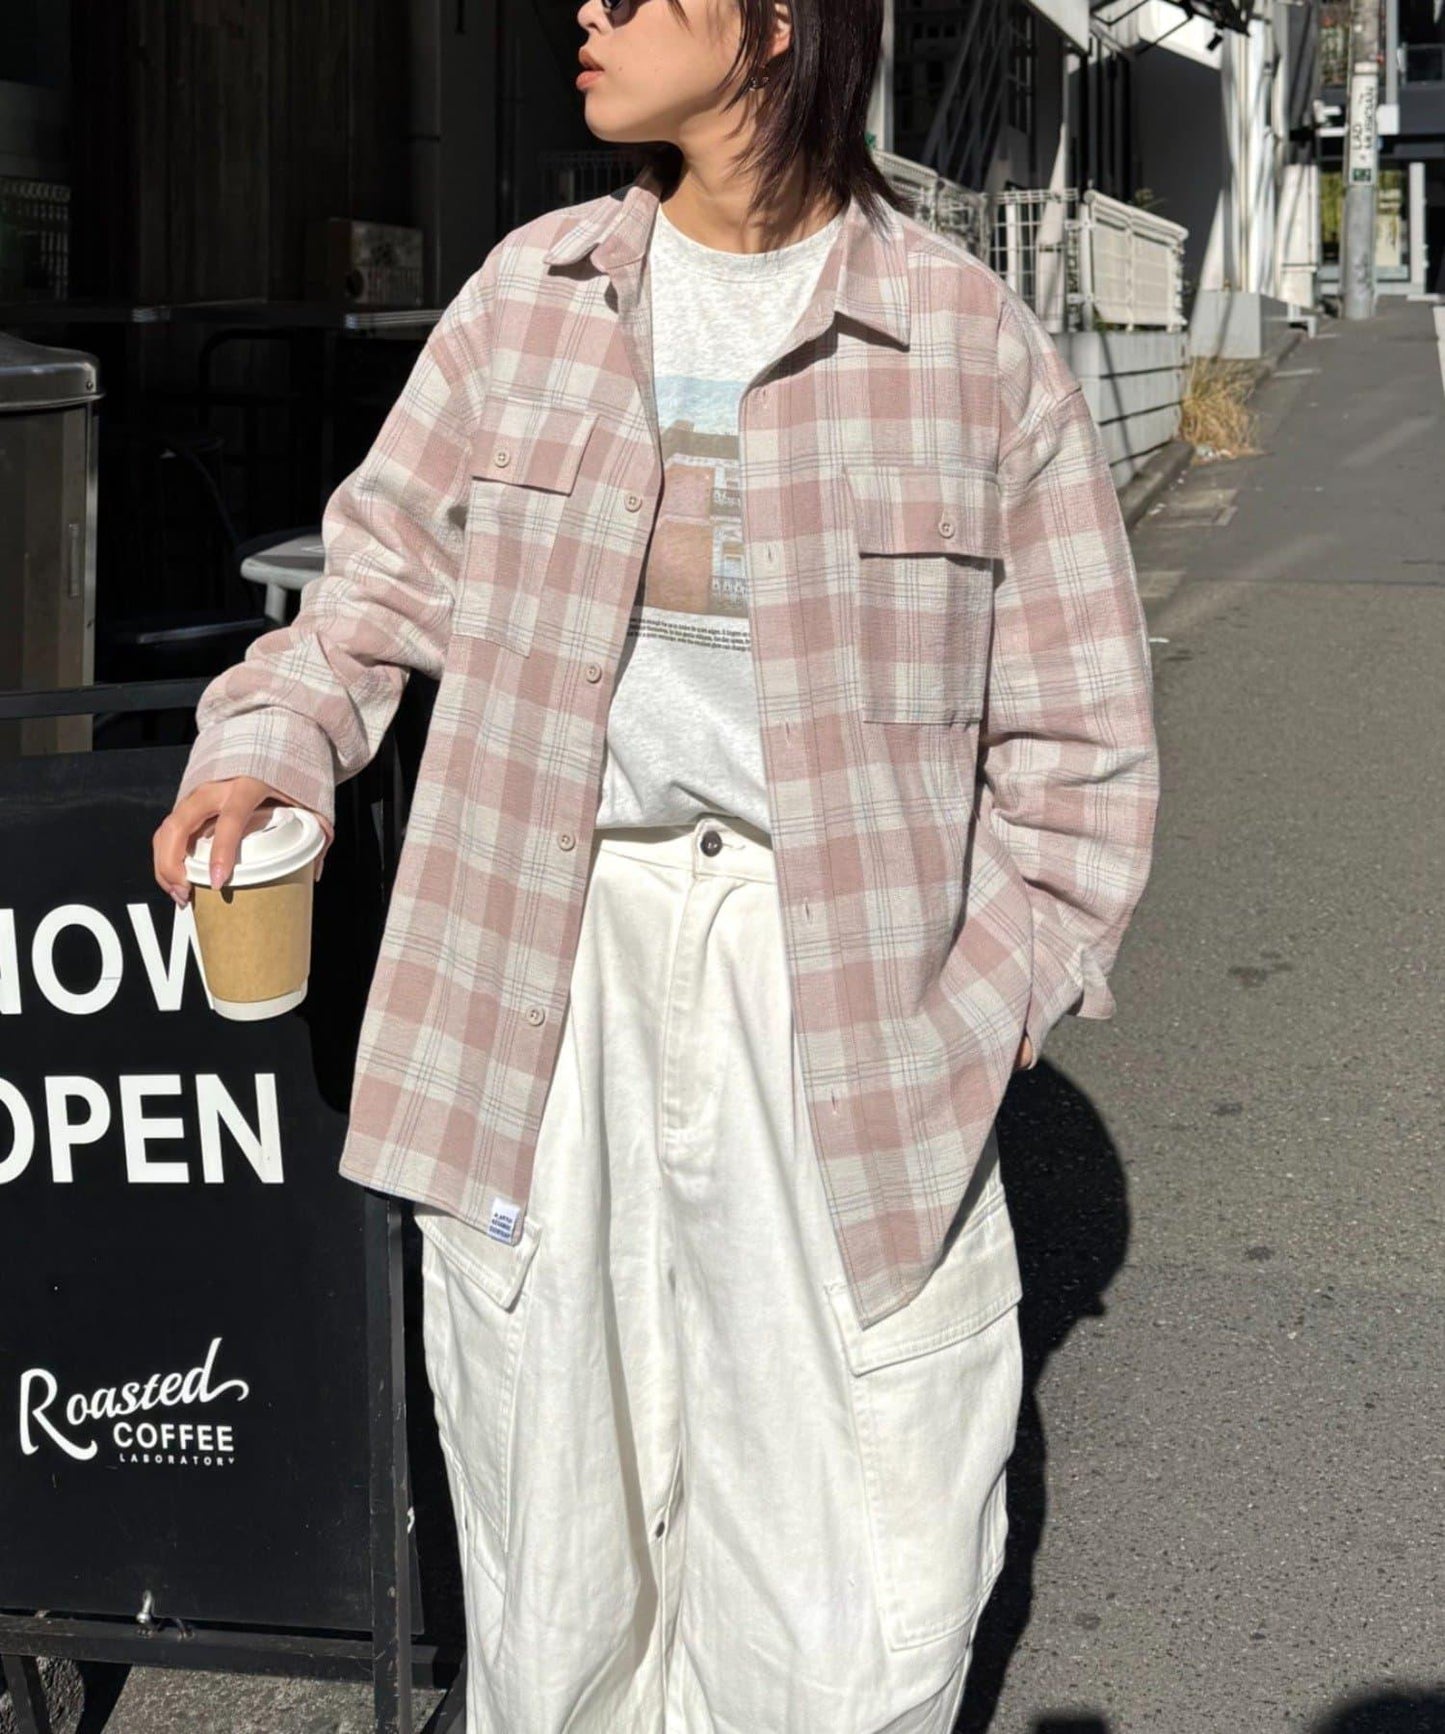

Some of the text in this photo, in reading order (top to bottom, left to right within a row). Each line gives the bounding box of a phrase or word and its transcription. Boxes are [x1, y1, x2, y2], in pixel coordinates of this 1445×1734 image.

[20, 1337, 249, 1460] Roasted
[113, 1422, 234, 1451] COFFEE
[119, 1453, 235, 1466] LABORATORY
